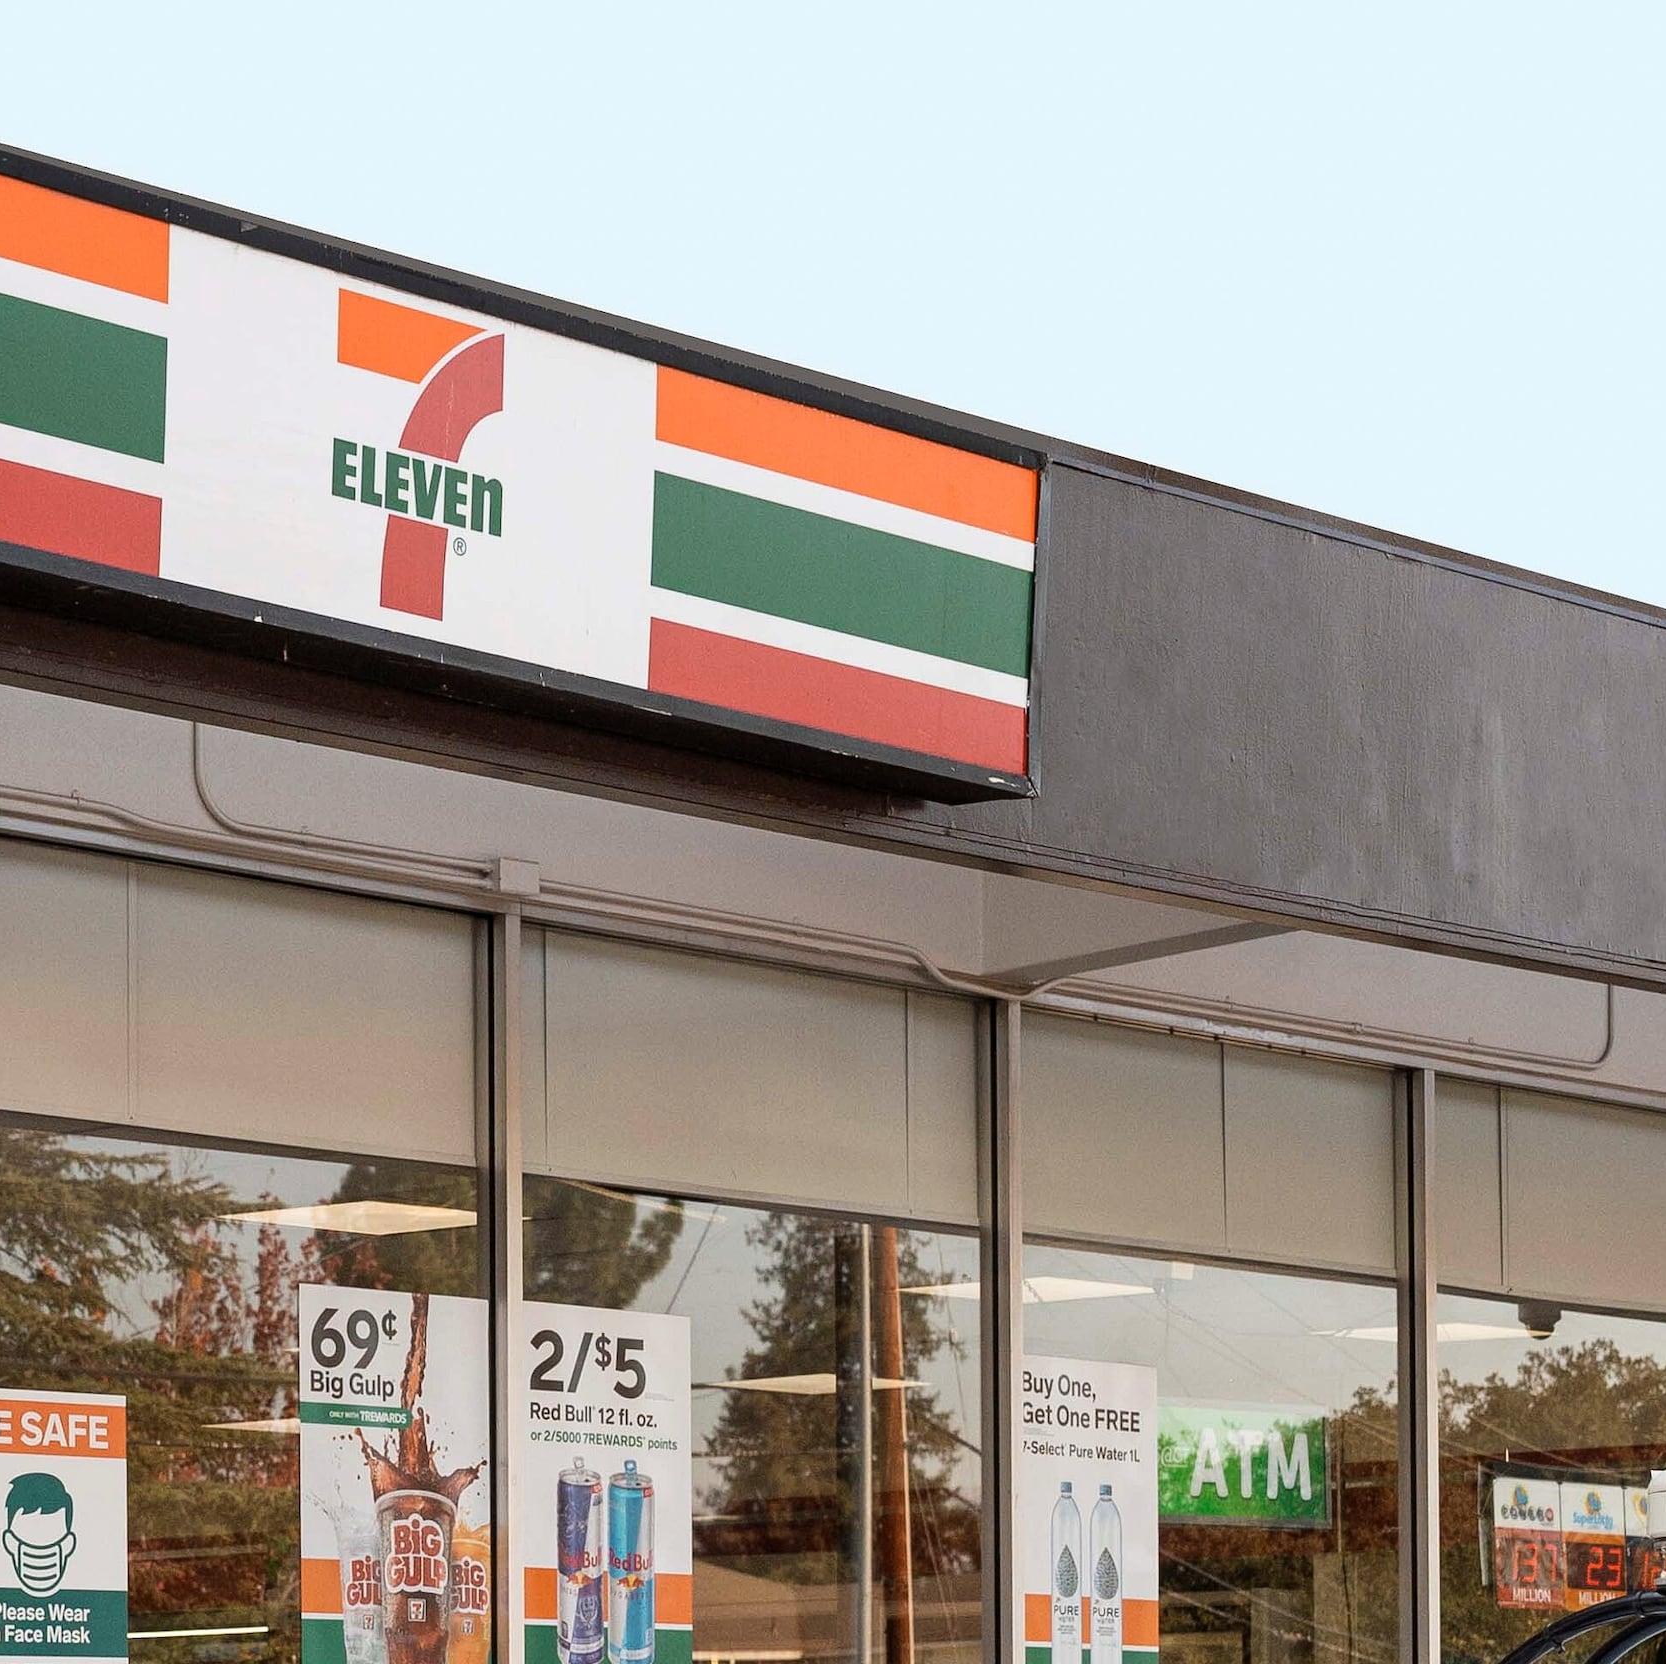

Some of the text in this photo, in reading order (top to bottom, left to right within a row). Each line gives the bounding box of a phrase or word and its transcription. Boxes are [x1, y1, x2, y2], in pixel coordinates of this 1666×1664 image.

[337, 287, 505, 622] 7
[530, 1329, 646, 1399] 2/$5
[310, 1370, 395, 1402] Big Gulp
[1023, 1371, 1096, 1402] Buy One,
[20, 1410, 109, 1449] SAFE
[530, 1402, 658, 1428] Red Bull 12 fl. oz.
[1023, 1402, 1140, 1432] Get One FREE
[530, 1431, 542, 1441] or
[543, 1430, 582, 1444] 2/5000
[647, 1438, 678, 1451] points
[1069, 1444, 1093, 1459] Pure
[1096, 1446, 1127, 1462] Water
[1130, 1450, 1140, 1462] 1L
[1190, 1428, 1312, 1500] ATM
[387, 1556, 448, 1590] GULP
[1512, 1543, 1558, 1583] 137
[1587, 1546, 1623, 1587] 23
[1054, 1604, 1079, 1616] PURE
[1513, 1588, 1551, 1602] MILLION
[48, 1603, 91, 1622] Wear
[1093, 1606, 1119, 1618] PURE
[4, 1624, 44, 1643] Face
[46, 1625, 90, 1644] Mask
